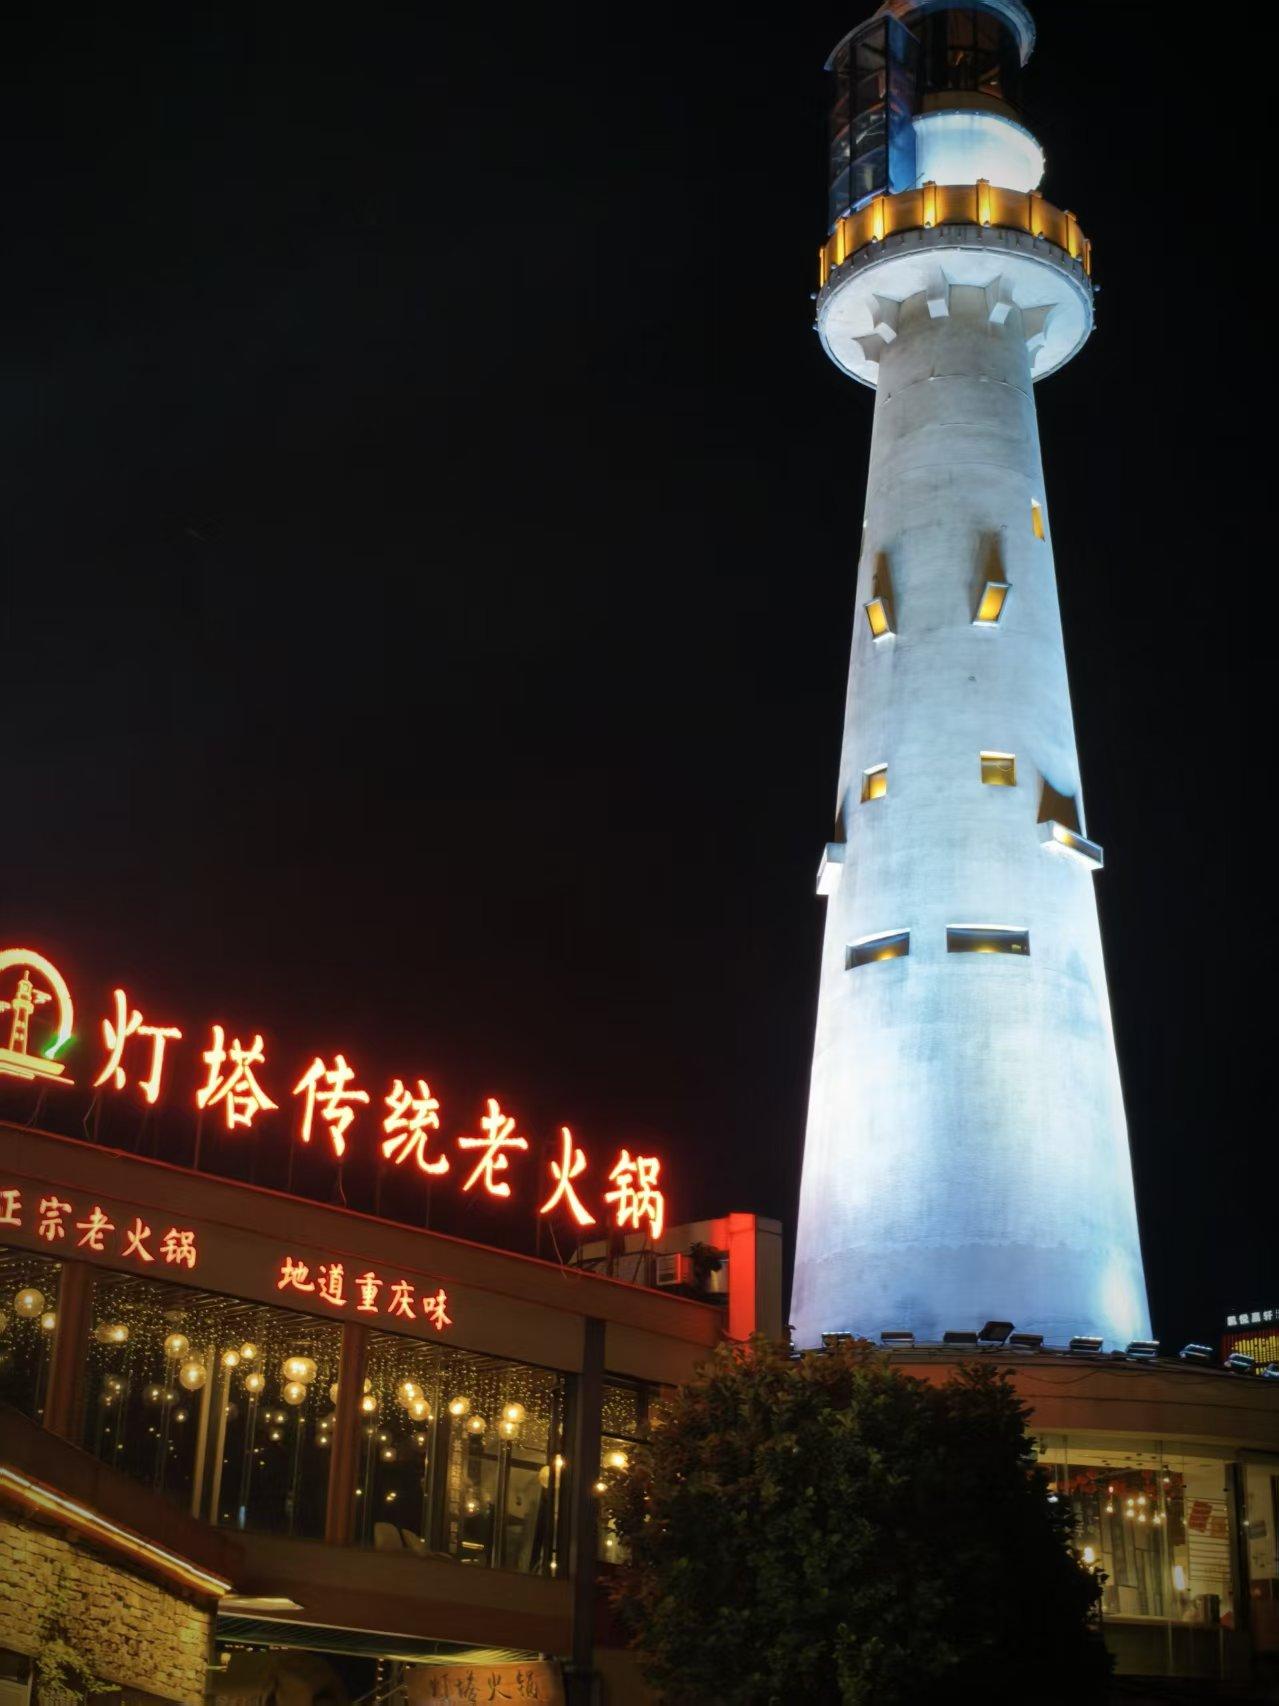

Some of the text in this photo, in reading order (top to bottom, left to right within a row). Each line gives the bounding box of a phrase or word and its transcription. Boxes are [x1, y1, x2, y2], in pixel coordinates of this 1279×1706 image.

[94, 988, 667, 1241] 灯塔传统老火锅
[0, 1188, 197, 1268] 正宗老火锅
[277, 1256, 454, 1331] 地道重庆味
